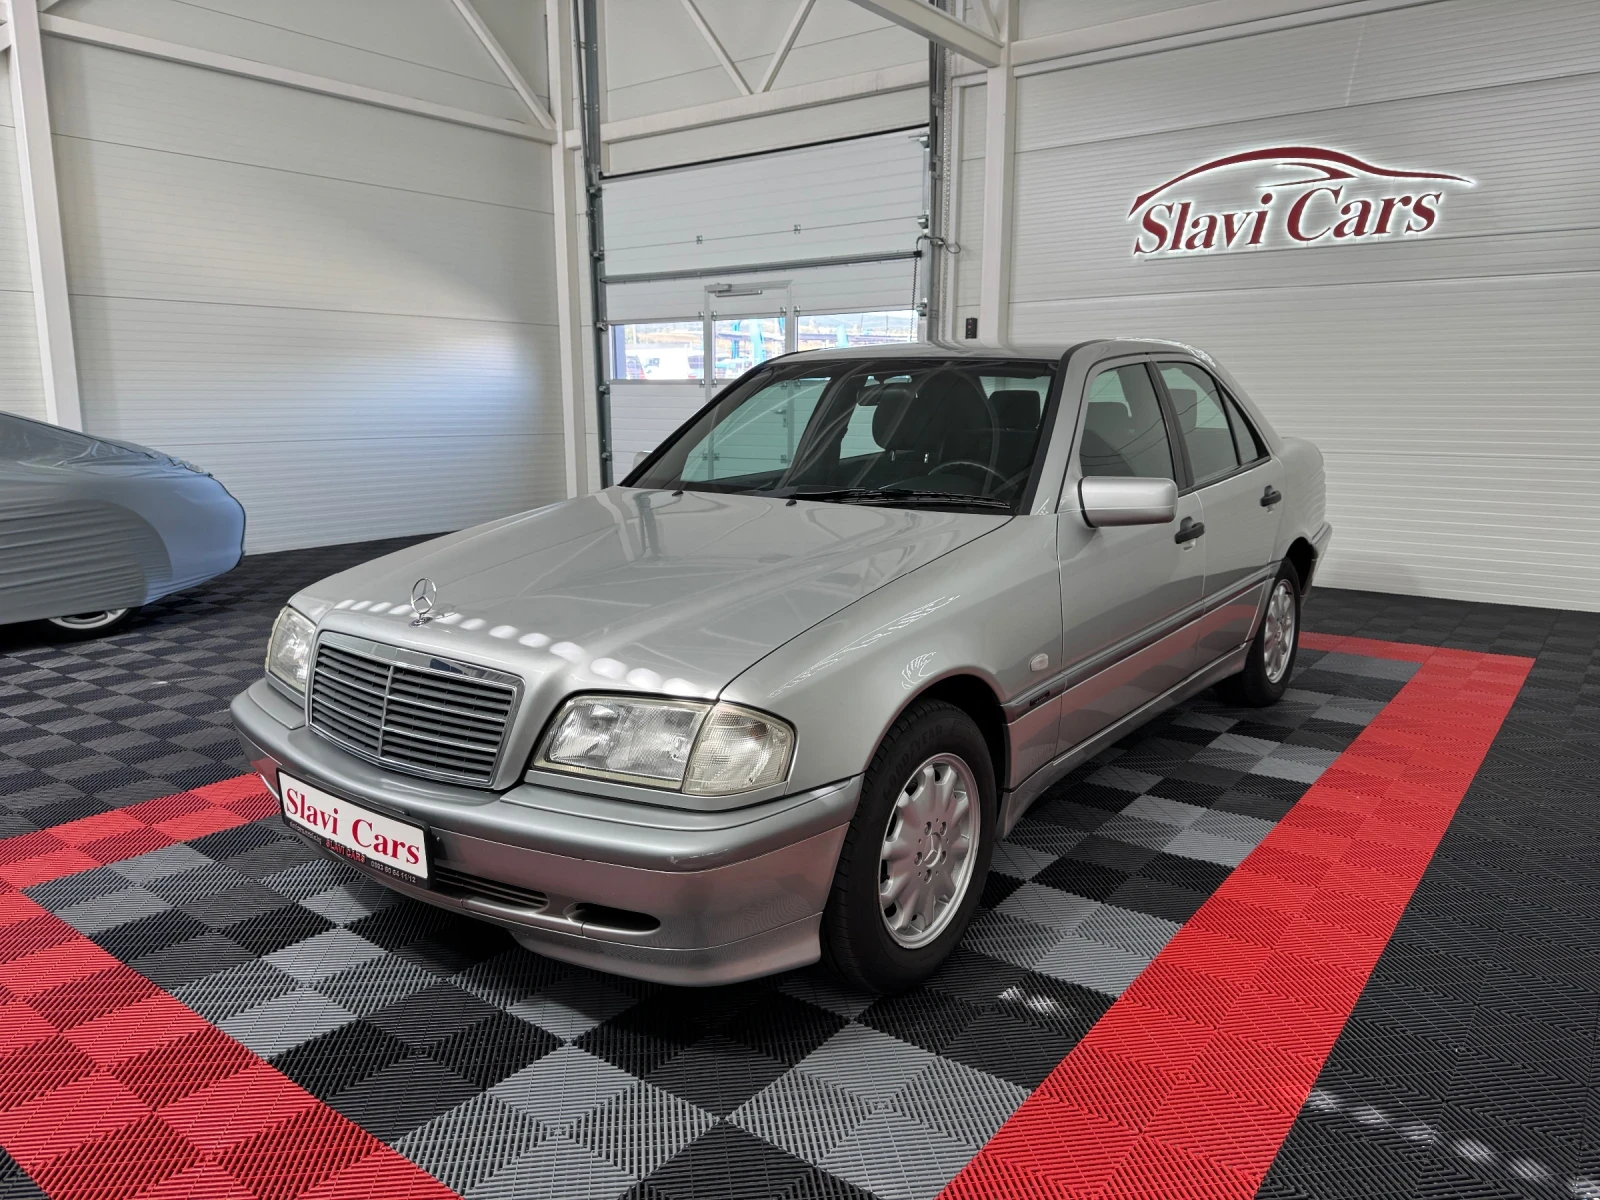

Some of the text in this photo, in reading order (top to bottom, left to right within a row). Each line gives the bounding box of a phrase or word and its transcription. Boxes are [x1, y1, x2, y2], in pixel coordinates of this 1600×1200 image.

[1133, 185, 1443, 255] Slavi Cars
[286, 787, 339, 836] Slavi
[351, 818, 420, 865] Cars
[325, 838, 366, 864] SLAVI CARS
